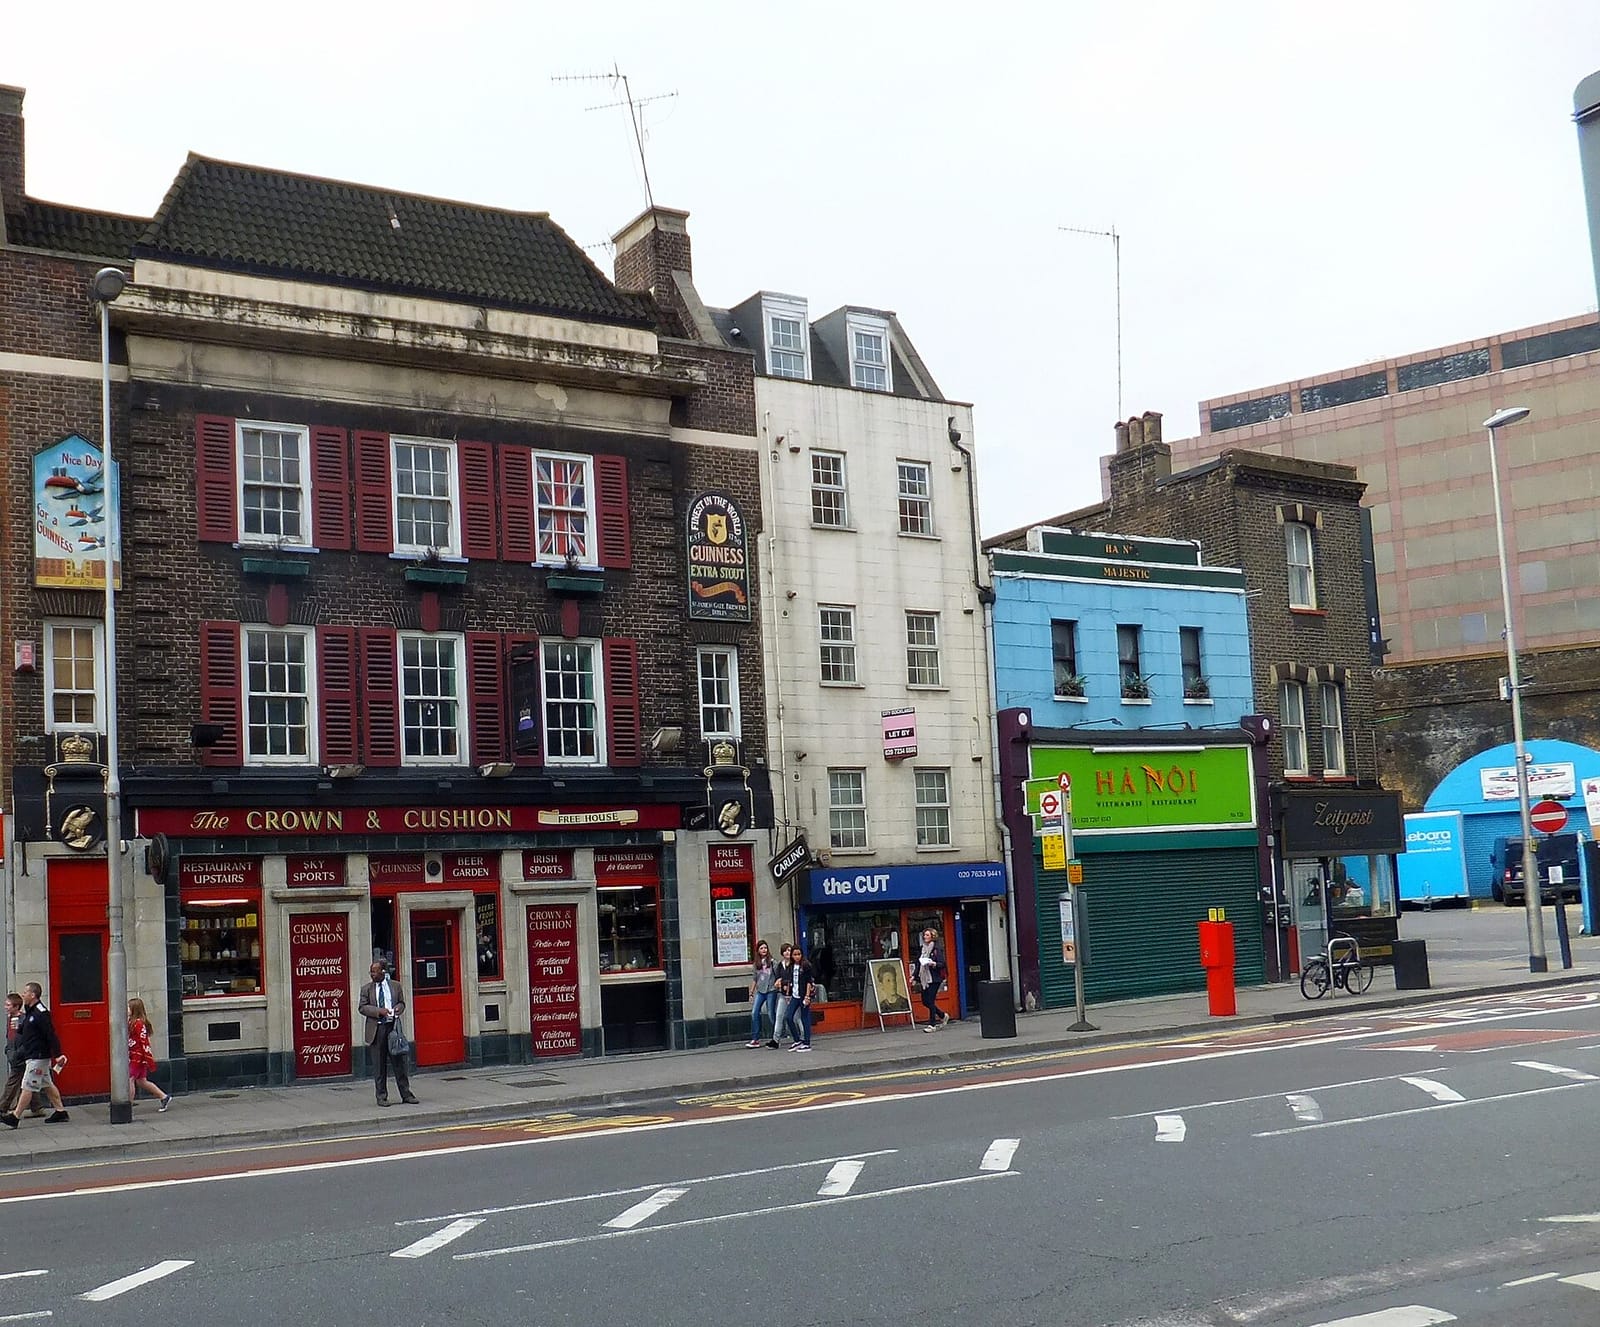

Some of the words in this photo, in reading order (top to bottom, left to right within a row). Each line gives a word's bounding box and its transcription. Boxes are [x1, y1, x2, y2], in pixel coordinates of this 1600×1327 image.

[62, 452, 81, 465] Nice
[85, 455, 103, 468] Day
[37, 503, 49, 520] for
[52, 516, 58, 526] a
[691, 499, 706, 531] FINEST
[704, 496, 713, 506] IN
[712, 495, 728, 509] THE
[727, 502, 742, 536] WORLD
[690, 545, 744, 565] GUINNESS
[690, 564, 718, 578] EXTRA
[719, 566, 745, 580] STOUT
[1103, 567, 1150, 579] MAJESTIC
[1060, 774, 1068, 786] A
[190, 811, 229, 830] The
[246, 810, 343, 831] CROWN
[366, 810, 381, 830] &
[404, 809, 512, 829] CUSHION
[558, 814, 580, 824] FREE
[585, 812, 619, 823] HOUSE
[1314, 801, 1373, 835] Zeitgeist
[533, 855, 557, 864] IRISH
[717, 849, 740, 858] FREE
[183, 861, 253, 873] RESTAURANT
[303, 860, 325, 870] SKY
[382, 862, 422, 873] GUINNESS
[458, 857, 484, 866] BEER
[714, 859, 744, 868] HOUSE
[773, 846, 805, 878] CARLING
[452, 867, 489, 877] GARDEN
[530, 865, 563, 875] SPORTS
[958, 871, 970, 879] 020
[193, 873, 244, 884] UPSTAIRS
[293, 871, 336, 882] SPORTS
[823, 877, 851, 895] the
[855, 874, 889, 893] CUT
[530, 911, 561, 920] CROWN
[293, 923, 331, 934] CROWN
[336, 922, 342, 932] &
[529, 920, 571, 931] CUSHION
[292, 933, 344, 944] CUSHION
[296, 965, 343, 977] UPSTAIRS
[542, 966, 563, 976] PUB
[303, 999, 326, 1009] THAI
[331, 998, 339, 1007] &
[533, 993, 553, 1004] REAL
[556, 992, 575, 1002] ALES
[302, 1008, 340, 1020] ENGLISH
[303, 1019, 340, 1032] FOOD
[535, 1038, 577, 1049] WELCOME
[303, 1055, 309, 1065] 7
[313, 1053, 341, 1064] DAYS
